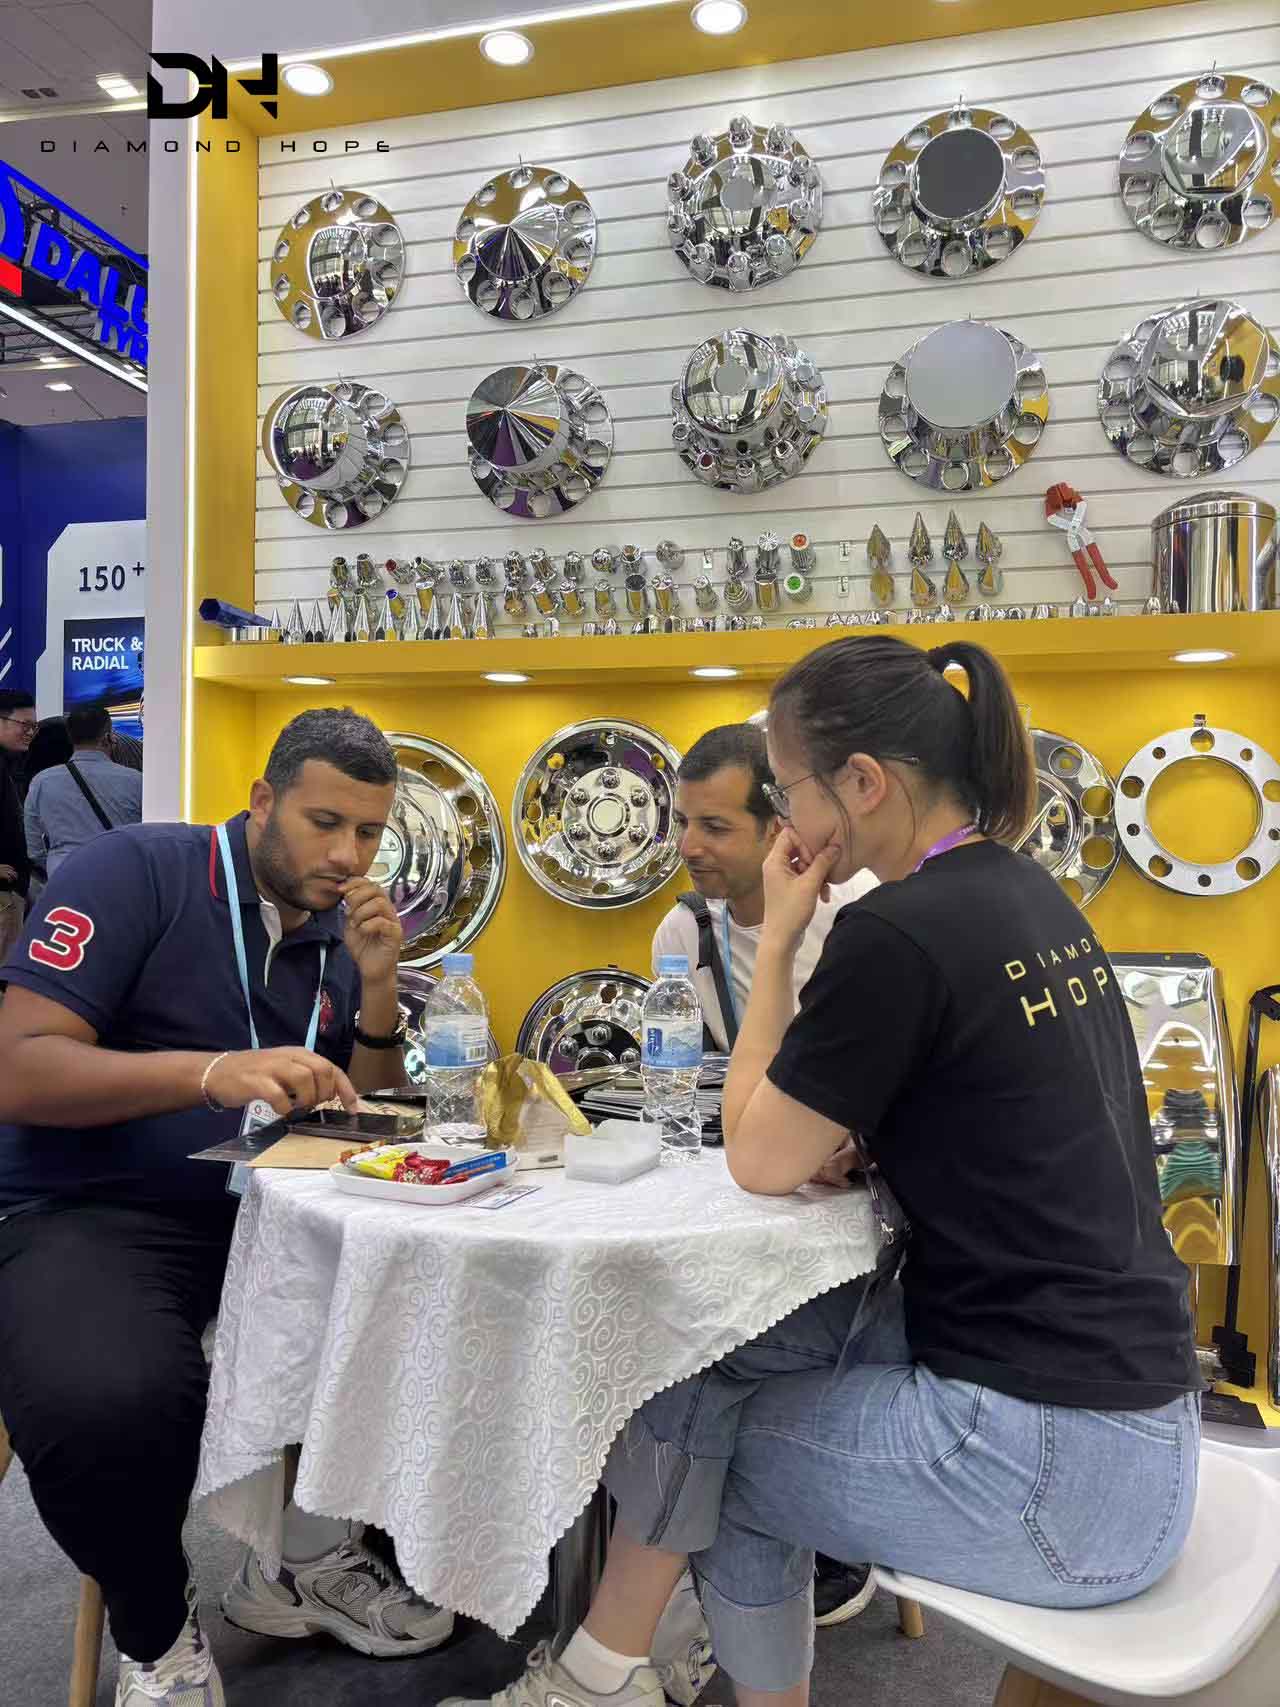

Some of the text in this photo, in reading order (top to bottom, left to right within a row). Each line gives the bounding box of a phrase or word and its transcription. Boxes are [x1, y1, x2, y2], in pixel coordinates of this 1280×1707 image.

[71, 636, 144, 653] TRUCK &
[71, 655, 129, 671] RADIAL
[28, 906, 95, 971] 3
[1004, 934, 1100, 981] DIAMO
